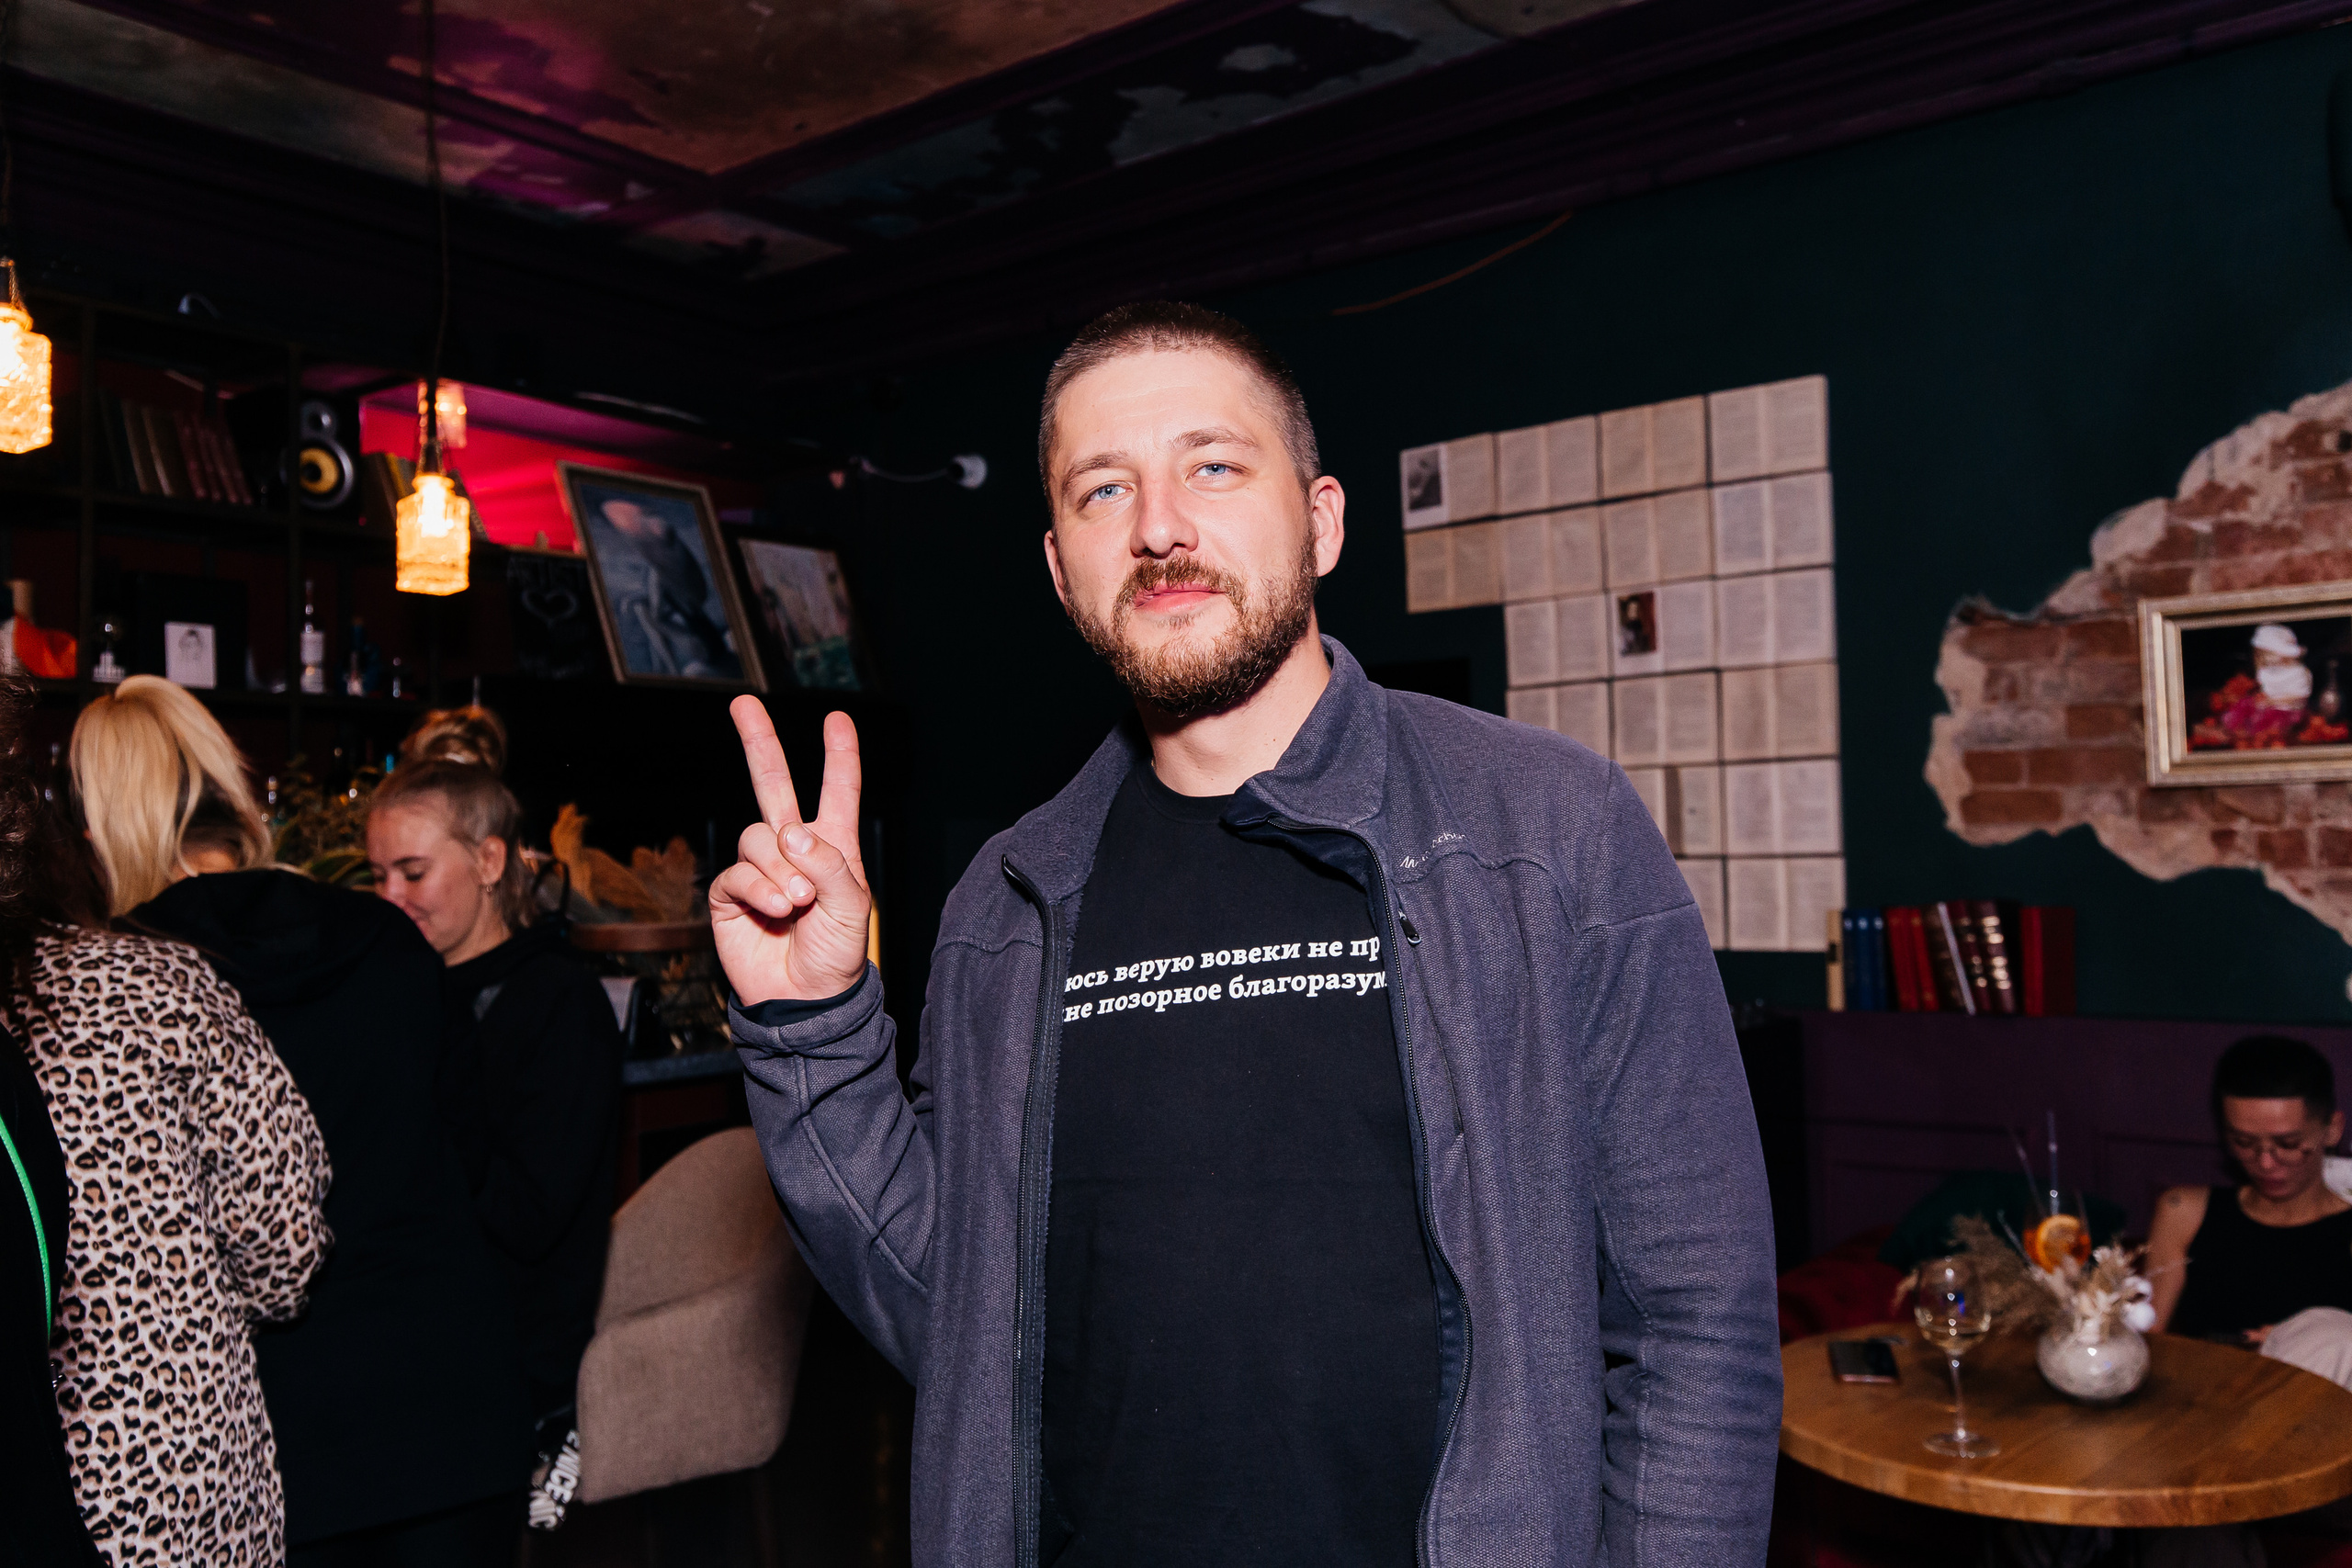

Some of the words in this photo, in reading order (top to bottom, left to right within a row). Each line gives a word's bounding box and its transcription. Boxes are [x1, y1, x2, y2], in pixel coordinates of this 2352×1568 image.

[1064, 970, 1109, 993] юсь
[1113, 955, 1195, 983] верую
[1199, 942, 1302, 969] вовеки
[1306, 941, 1343, 958] не
[1349, 936, 1381, 963] пр
[1062, 1002, 1093, 1022] не
[1096, 983, 1222, 1015] позорное
[1228, 970, 1387, 999] благоразум
